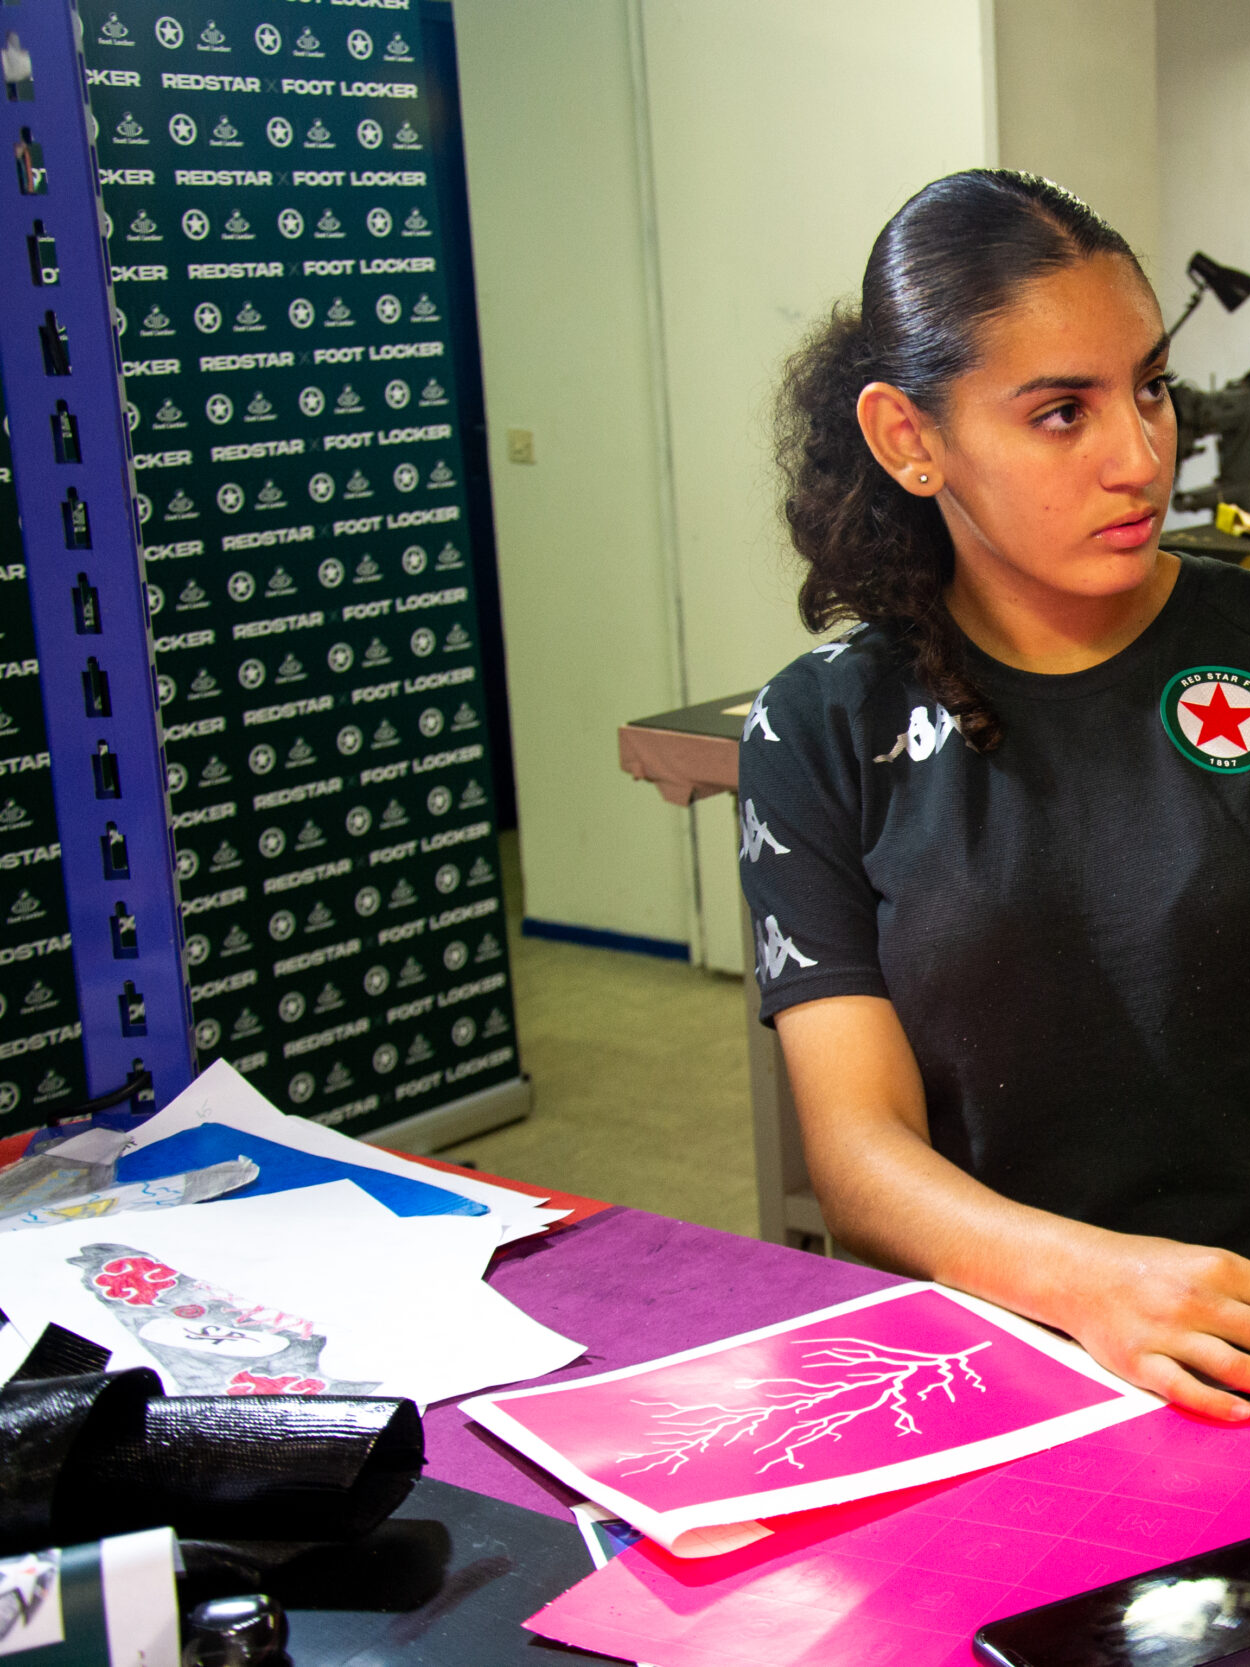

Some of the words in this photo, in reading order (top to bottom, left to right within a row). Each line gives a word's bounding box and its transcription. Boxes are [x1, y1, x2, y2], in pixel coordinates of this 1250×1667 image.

[162, 73, 261, 92] REDSTAR
[282, 79, 336, 95] FOOT
[341, 81, 419, 98] LOCKER
[99, 169, 155, 185] CKER
[176, 170, 273, 186] REDSTAR
[293, 171, 346, 186] FOOT
[351, 171, 427, 186] LOCKER
[111, 265, 168, 281] CKER
[189, 262, 284, 279] REDSTAR
[304, 260, 355, 276] FOOT
[360, 258, 436, 275] LOCKER
[121, 358, 181, 377] CKER
[200, 352, 294, 372] REDSTAR
[314, 347, 365, 364] FOOT
[370, 342, 444, 361] LOCKER
[133, 450, 193, 470] CKER
[212, 439, 304, 462] REDSTAR
[324, 432, 375, 451] FOOT
[379, 424, 452, 445] LOCKER
[144, 540, 204, 562] CKER
[223, 526, 314, 552] REDSTAR
[334, 516, 383, 536] FOOT
[388, 506, 460, 529] LOCKER
[154, 629, 215, 652] CKER
[233, 612, 324, 640] REDSTAR
[343, 600, 391, 622] FOOT
[397, 588, 468, 613] LOCKER
[244, 695, 334, 726] REDSTAR
[352, 681, 400, 704] FOOT
[405, 667, 475, 693] LOCKER
[1181, 674, 1202, 687] RED
[1207, 672, 1238, 683] STAR
[254, 777, 342, 810] REDSTAR
[361, 761, 409, 785] FOOT
[413, 745, 483, 773] LOCKER
[1210, 758, 1237, 767] 1897
[181, 886, 247, 916] OCKER
[264, 858, 351, 895] REDSTAR
[191, 970, 257, 1003] OCKER
